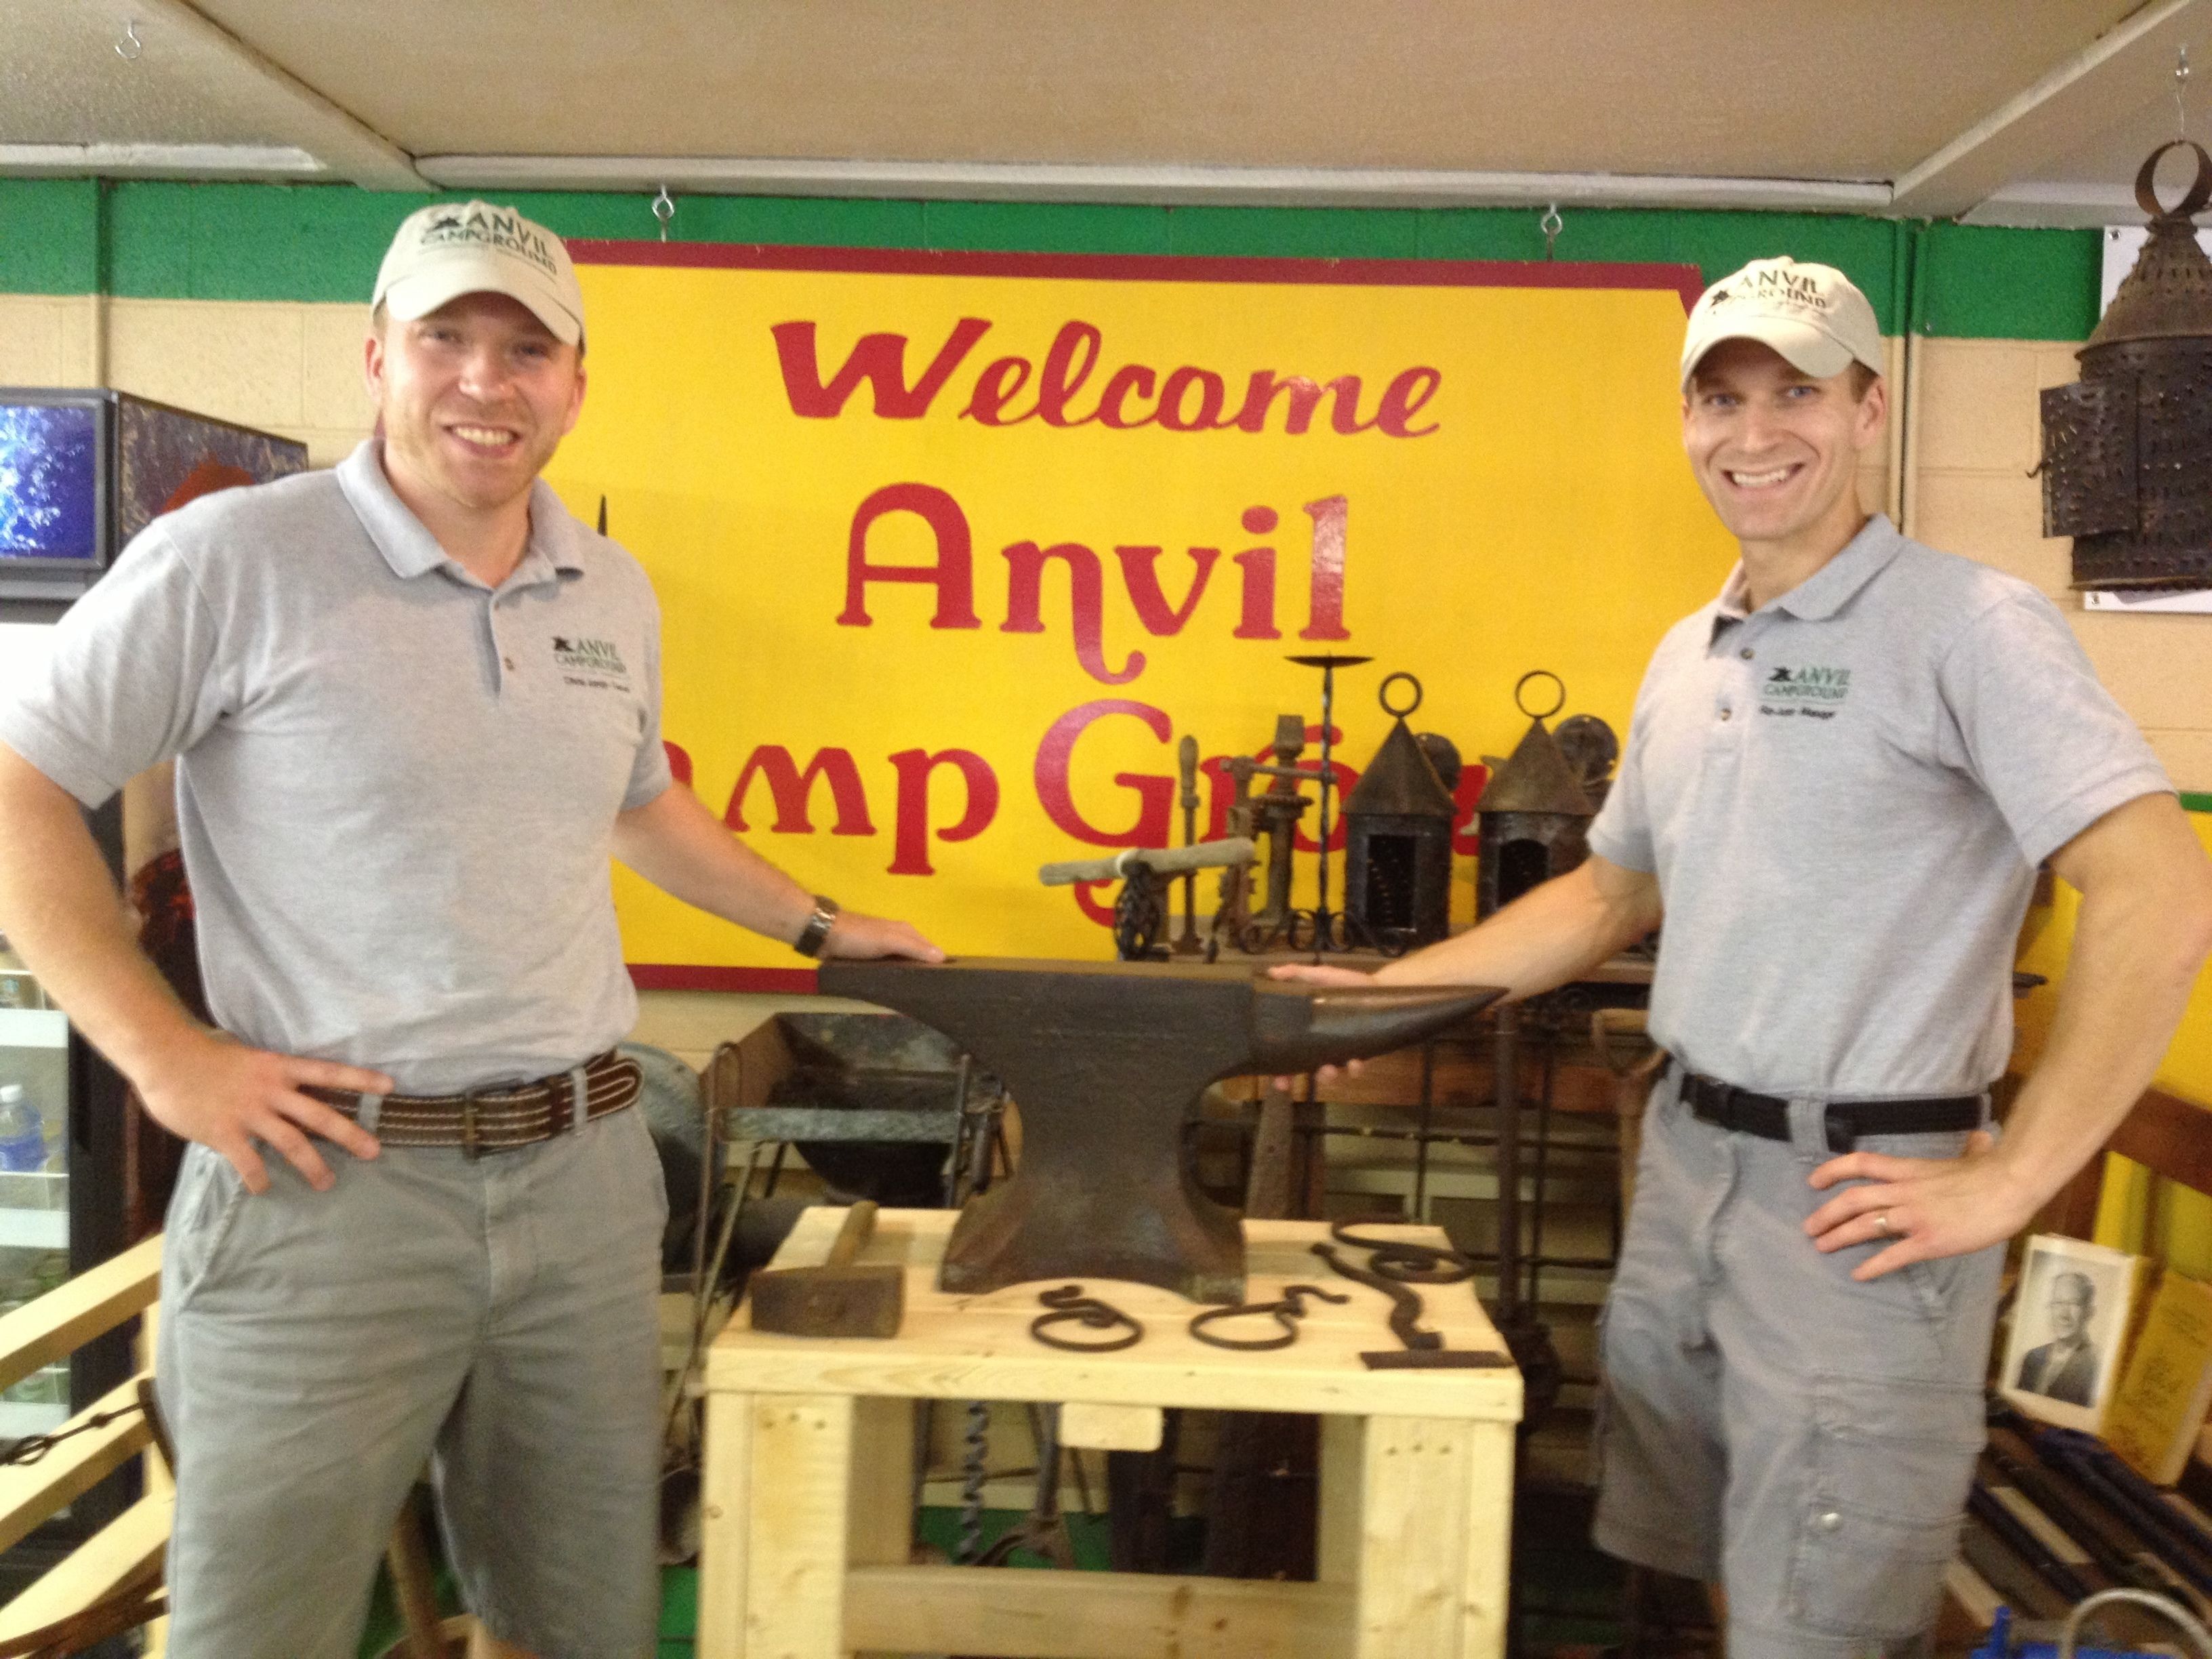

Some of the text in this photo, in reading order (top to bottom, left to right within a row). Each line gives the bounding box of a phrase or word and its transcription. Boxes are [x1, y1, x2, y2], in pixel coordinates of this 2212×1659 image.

[466, 213, 554, 260] ANVIL
[771, 317, 1441, 438] Welcome
[836, 482, 1350, 682] Anvil
[663, 739, 1000, 876] mp
